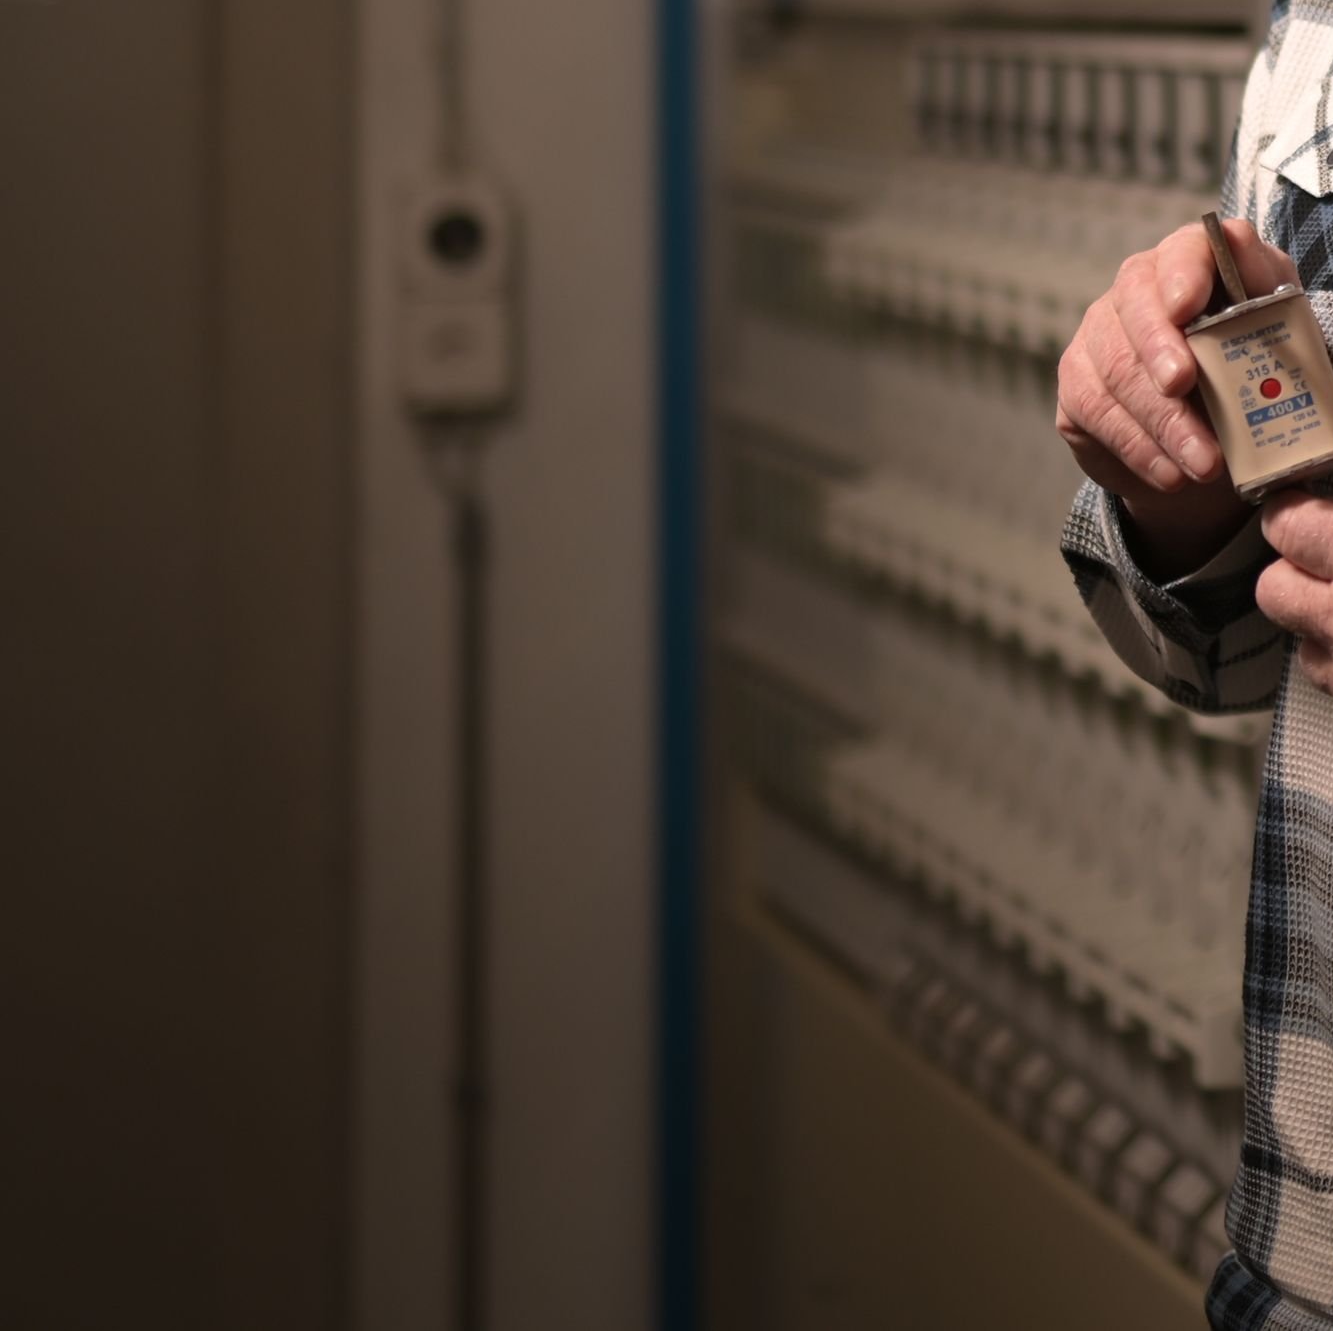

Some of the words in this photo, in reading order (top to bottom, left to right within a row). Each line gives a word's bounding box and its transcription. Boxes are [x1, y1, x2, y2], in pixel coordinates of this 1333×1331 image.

[1246, 364, 1271, 381] 315
[1274, 359, 1285, 372] A
[1267, 401, 1294, 418] 400
[1297, 395, 1308, 407] V
